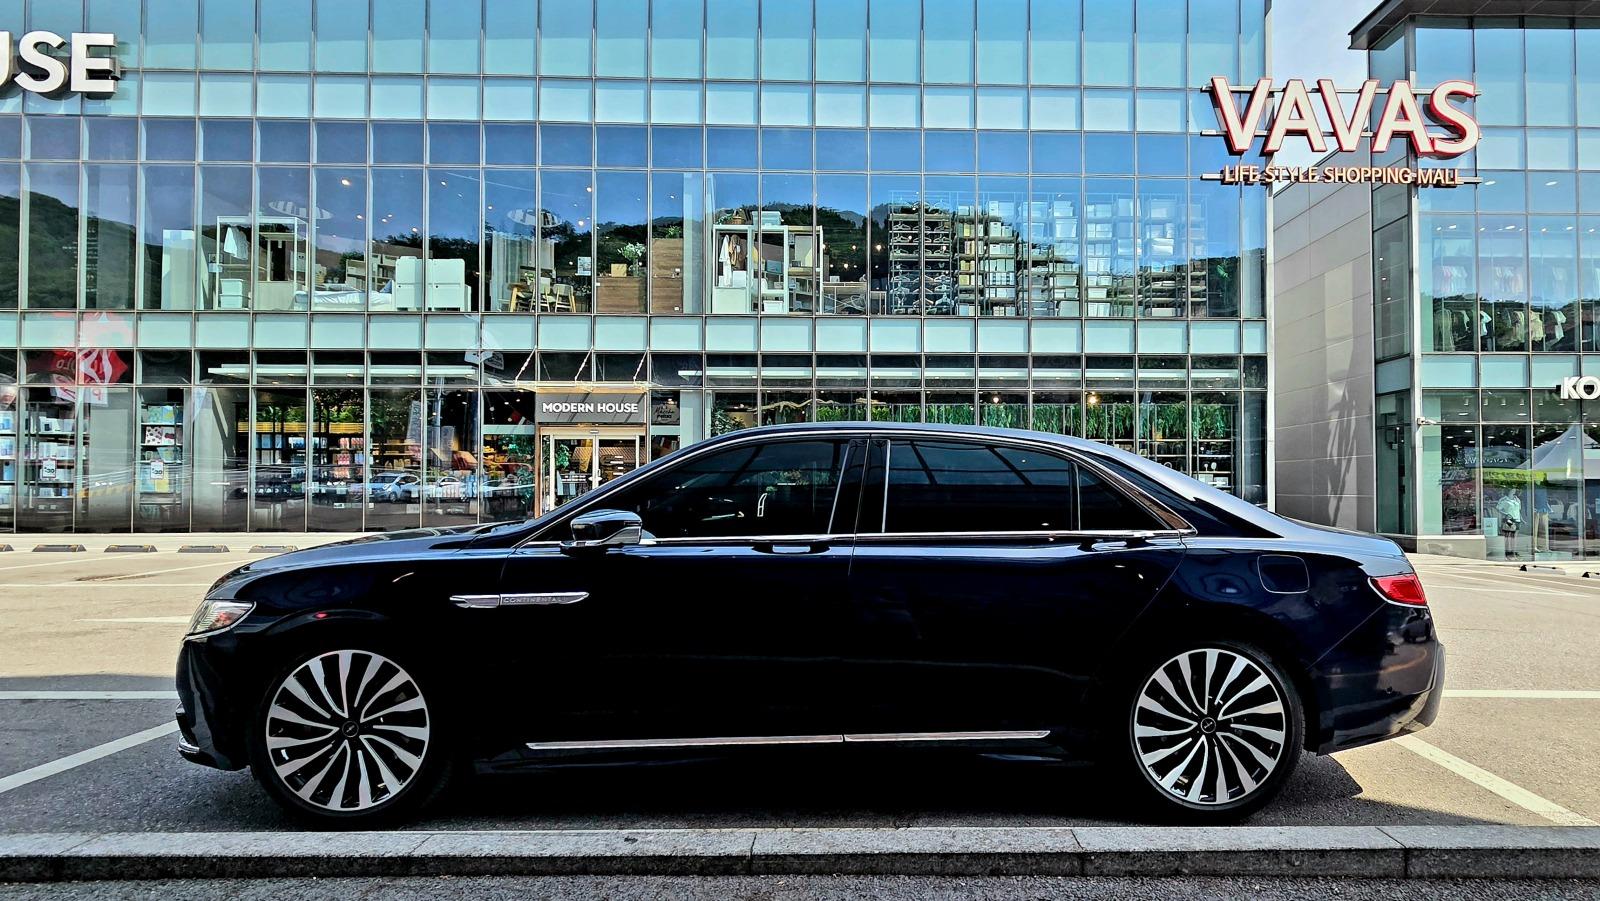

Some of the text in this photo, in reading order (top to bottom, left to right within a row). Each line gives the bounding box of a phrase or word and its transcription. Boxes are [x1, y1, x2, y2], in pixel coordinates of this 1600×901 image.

[1212, 77, 1480, 157] VAVAS
[1224, 165, 1464, 185] LIFE STYLE SHOPPING MALL
[1560, 376, 1600, 399] KO
[542, 403, 638, 413] MODERN HOUSE
